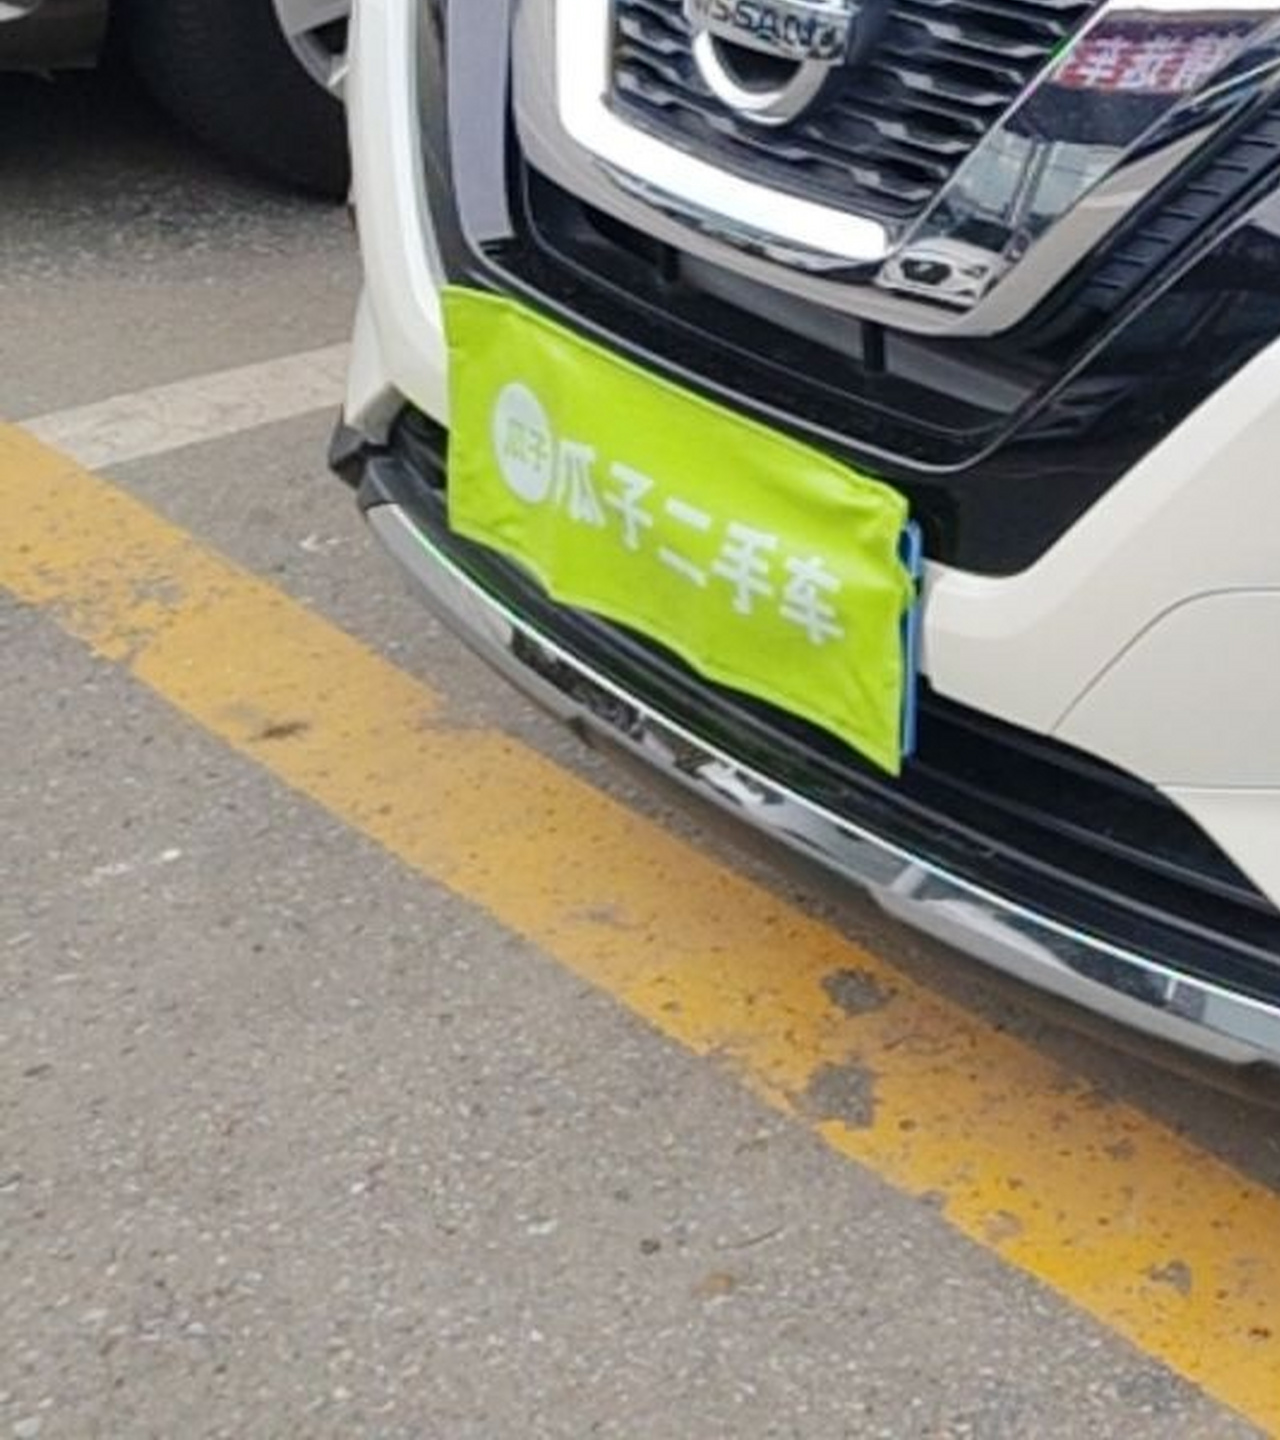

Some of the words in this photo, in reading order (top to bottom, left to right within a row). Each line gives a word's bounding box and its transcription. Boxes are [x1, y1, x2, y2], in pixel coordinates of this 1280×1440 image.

[554, 437, 845, 646] 瓜子二手车
